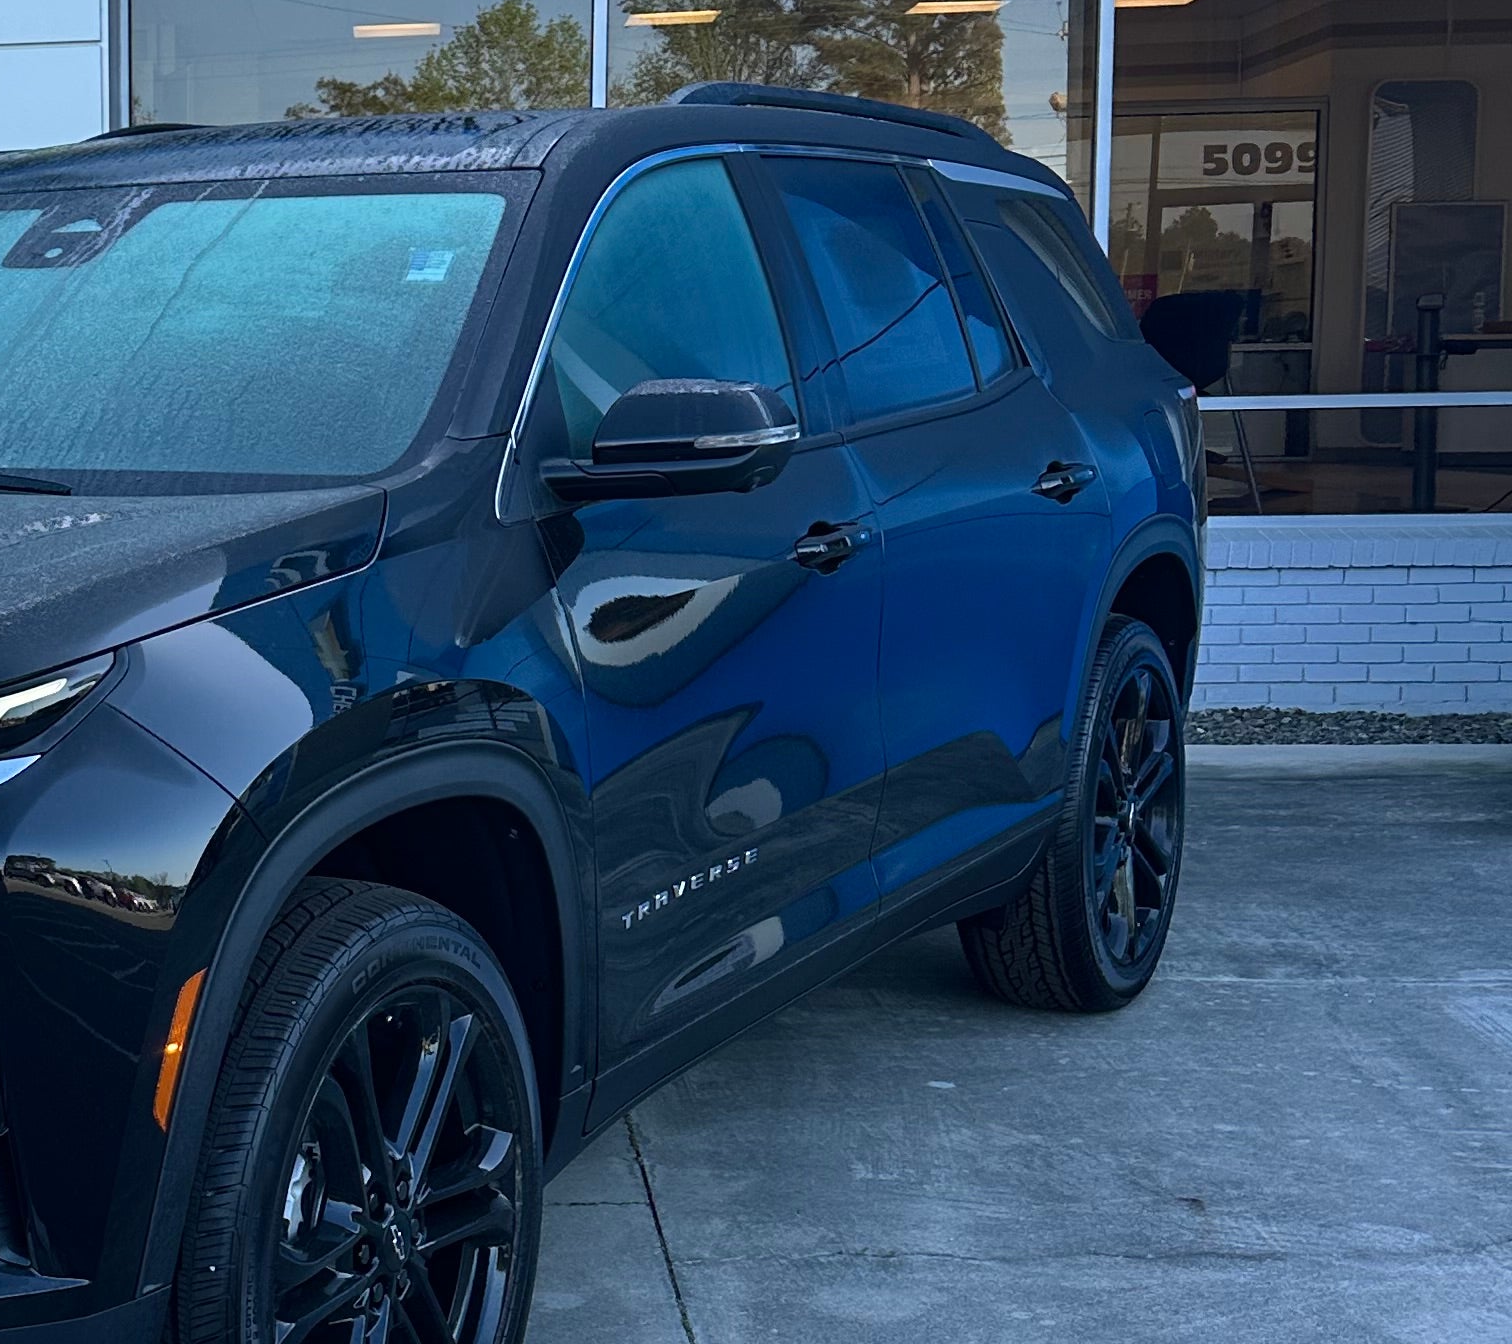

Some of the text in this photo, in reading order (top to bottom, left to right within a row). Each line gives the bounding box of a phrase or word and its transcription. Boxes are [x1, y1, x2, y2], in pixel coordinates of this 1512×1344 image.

[1202, 141, 1316, 176] 5099
[621, 847, 759, 930] TRAVERSE
[351, 935, 481, 994] CONNENTAL
